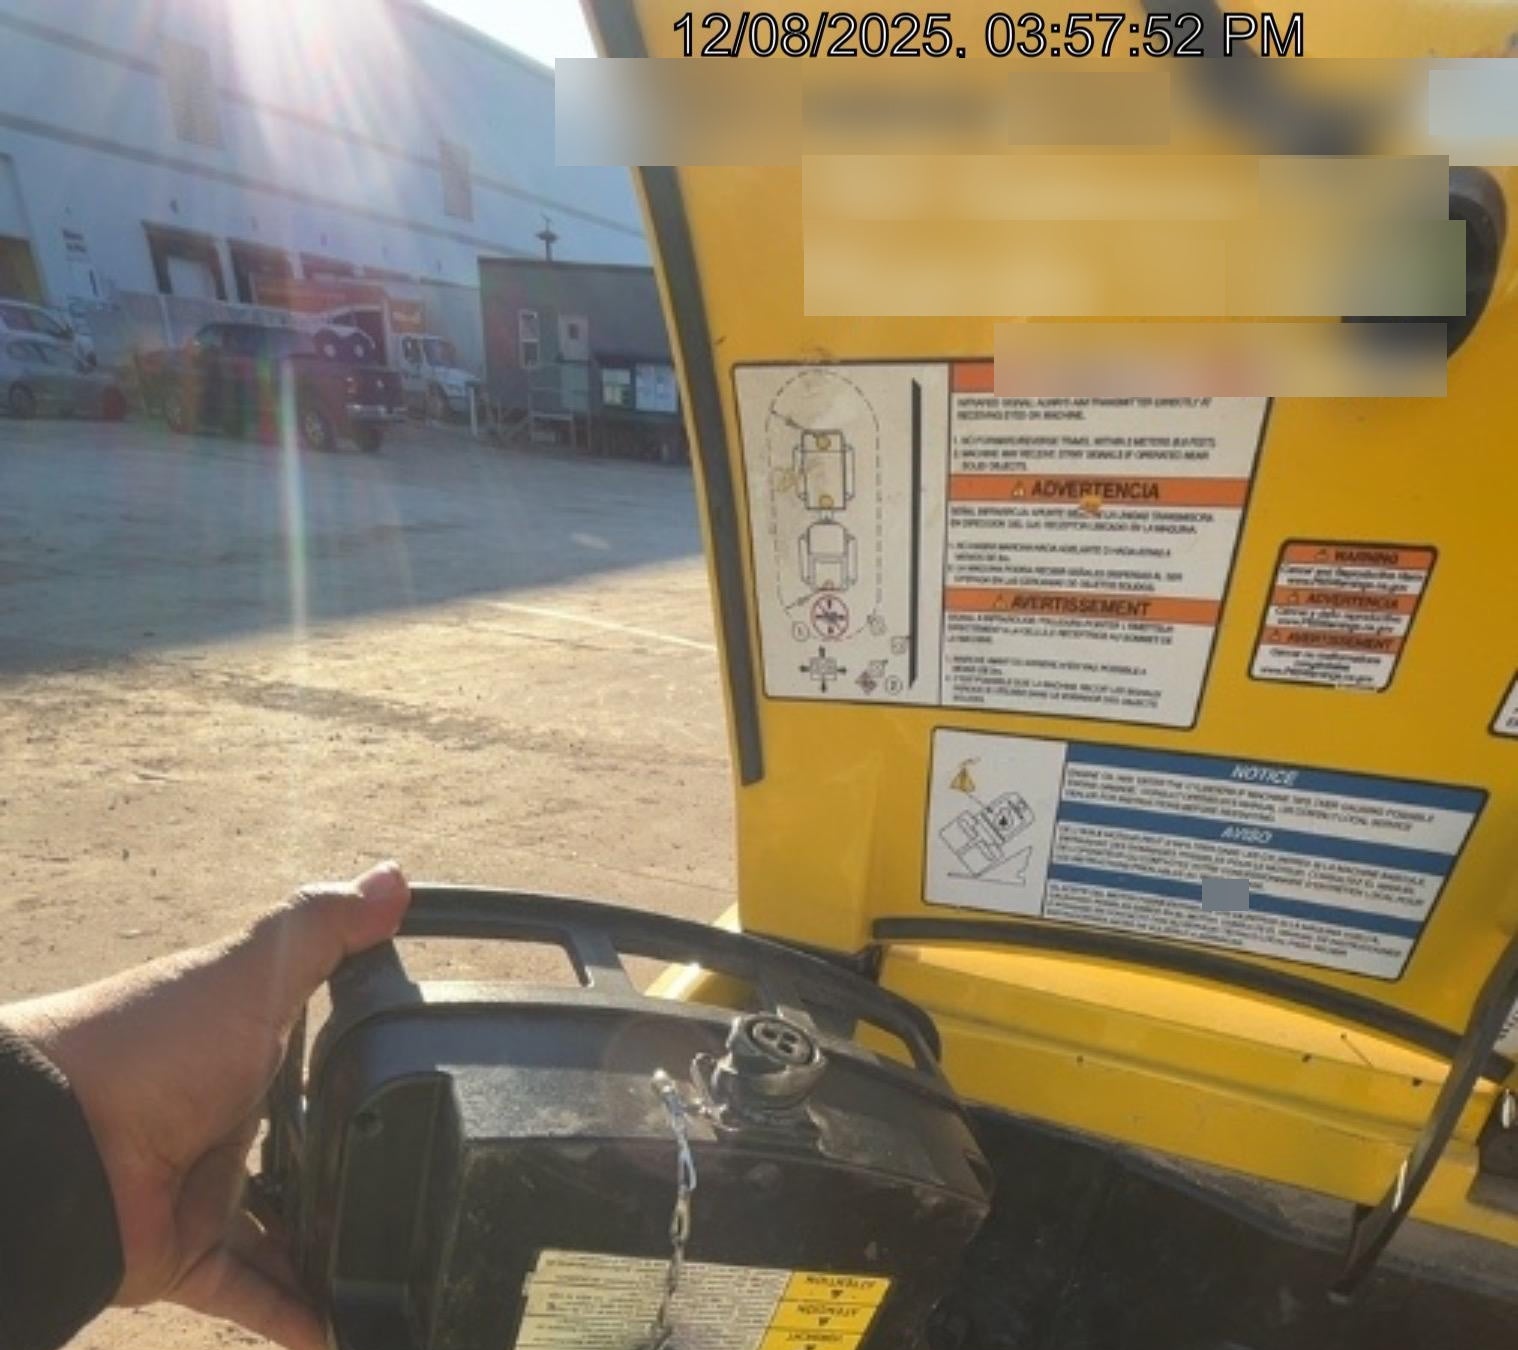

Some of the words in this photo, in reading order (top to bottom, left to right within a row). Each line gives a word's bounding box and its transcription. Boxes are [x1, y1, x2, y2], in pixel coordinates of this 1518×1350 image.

[1031, 480, 1160, 499] ADVERTENCIA
[1010, 595, 1151, 616] AVERTISSEMENT
[1231, 764, 1299, 786] NOTICE
[1220, 826, 1272, 844] AVISO
